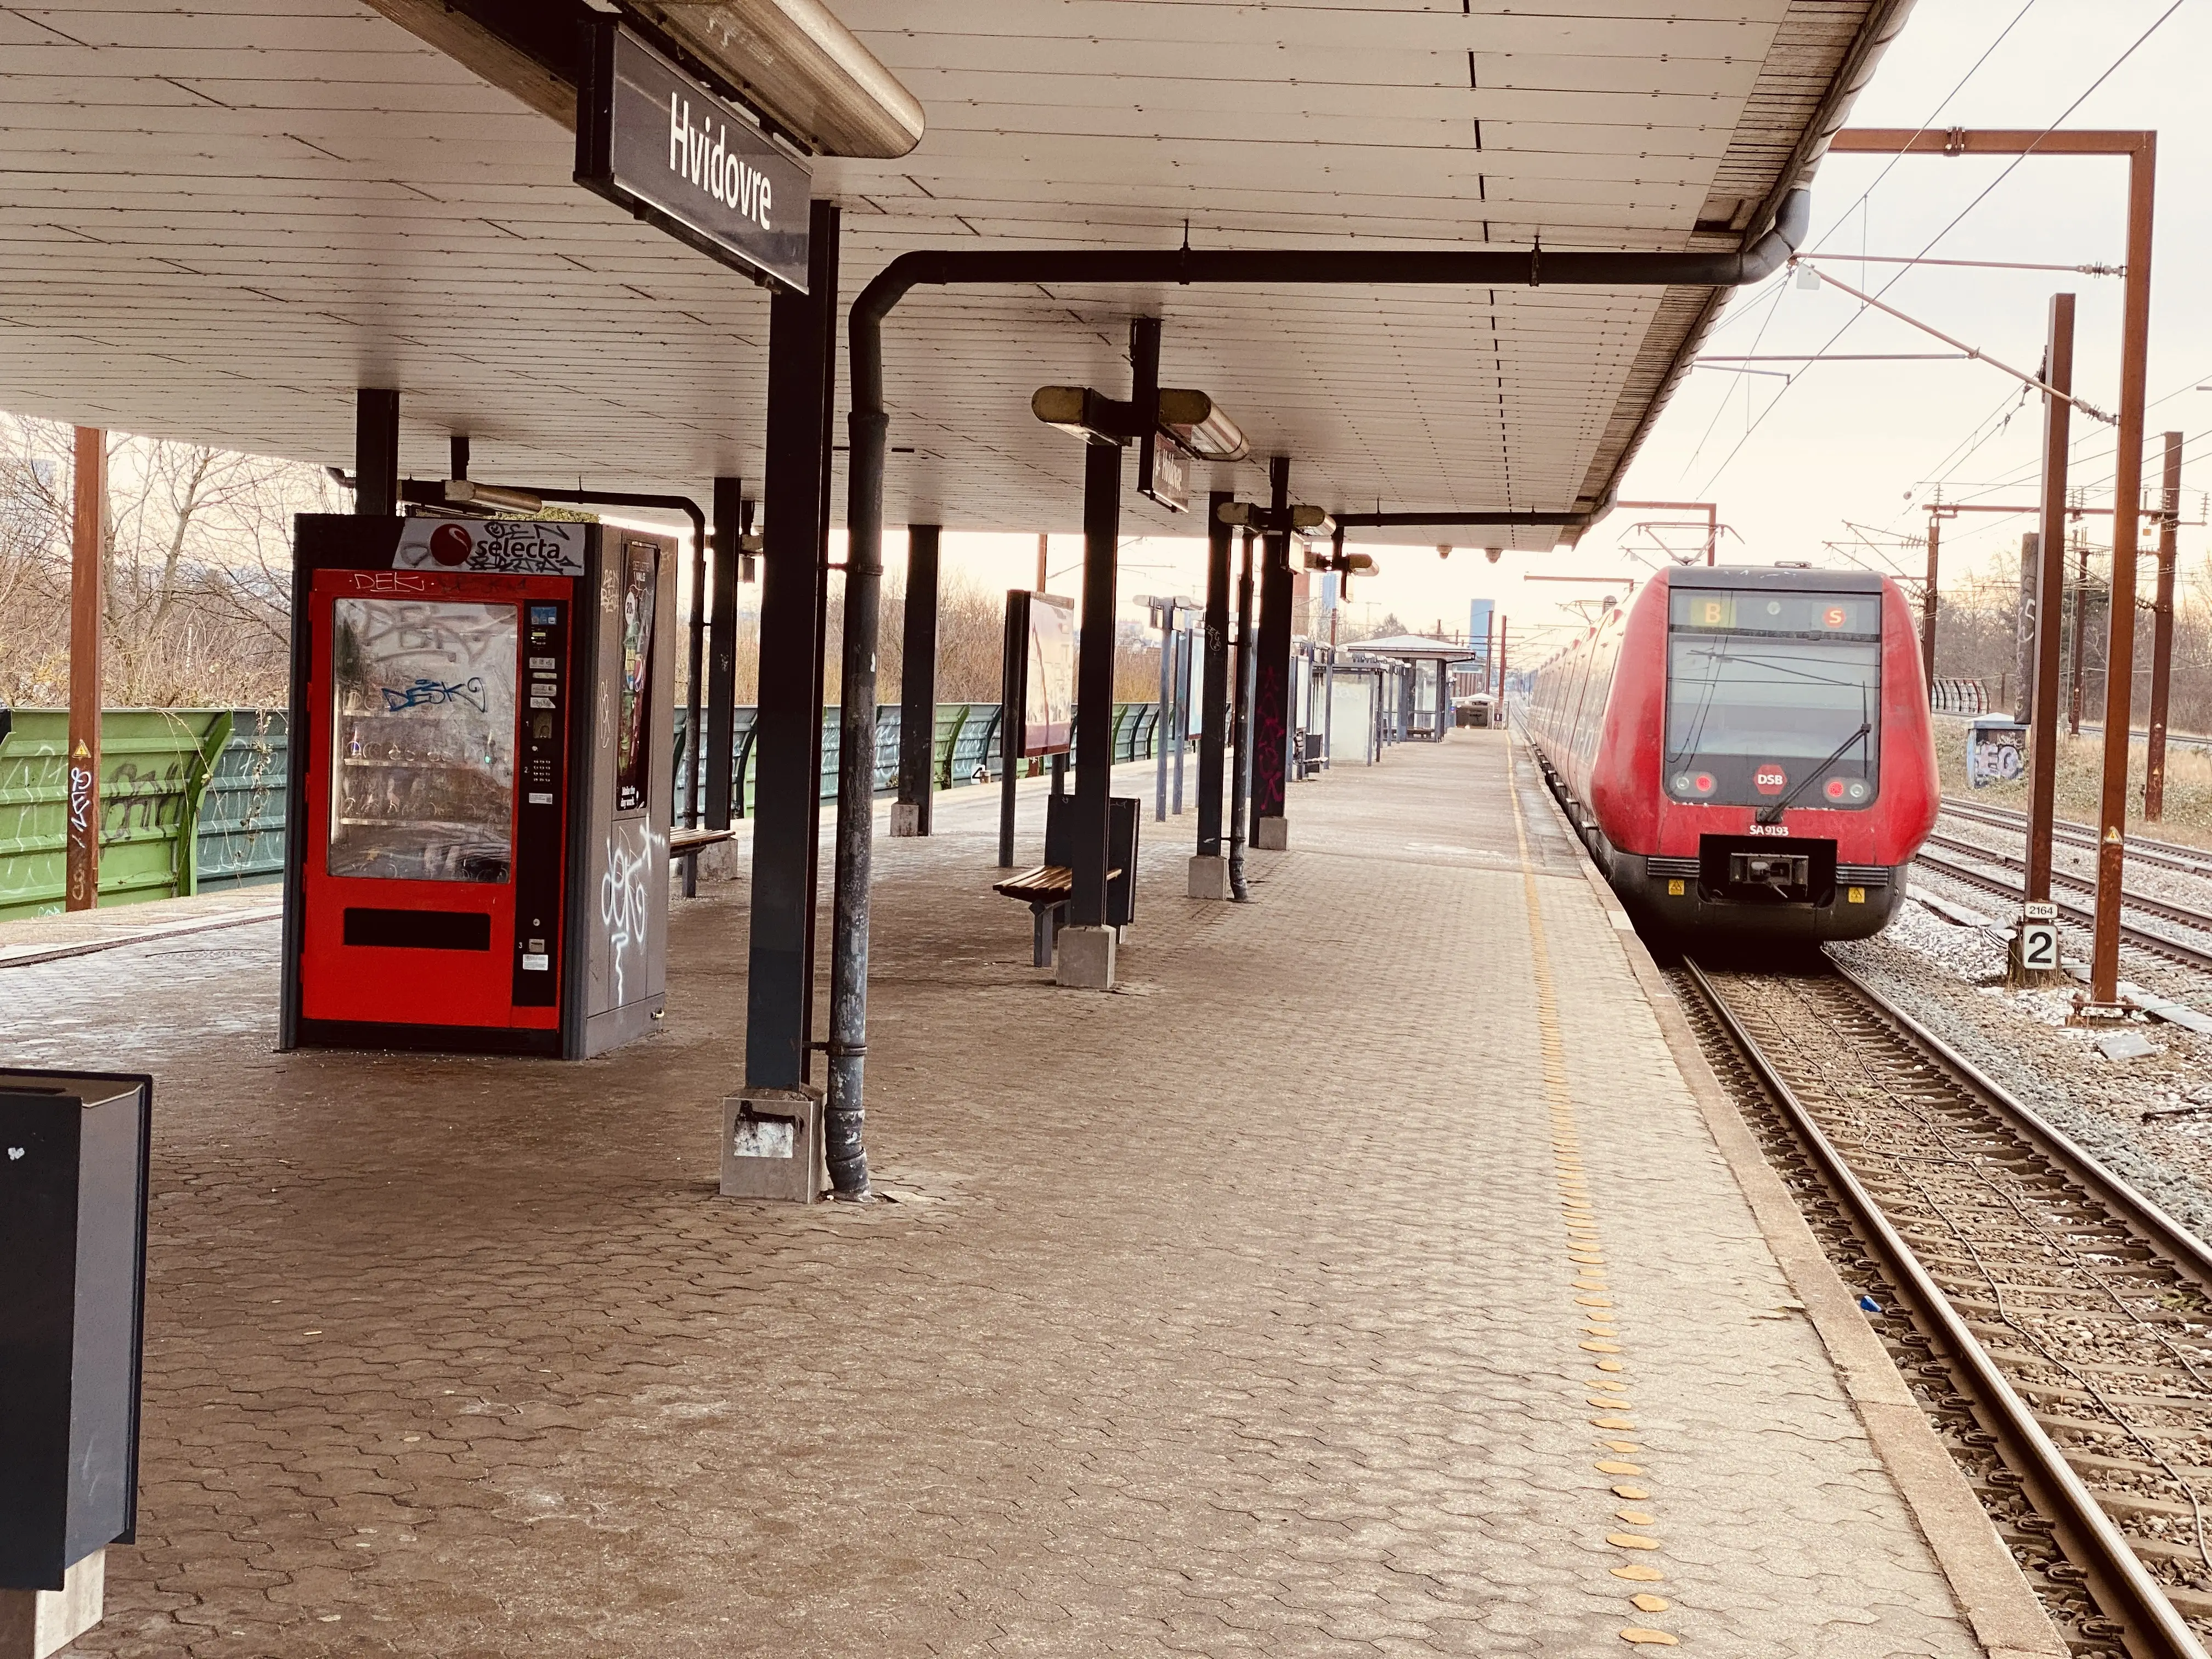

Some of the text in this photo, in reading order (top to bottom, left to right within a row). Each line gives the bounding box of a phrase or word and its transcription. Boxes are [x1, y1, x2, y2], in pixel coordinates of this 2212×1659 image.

[669, 91, 772, 231] Hvidovre
[475, 538, 561, 560] selecta
[1704, 602, 1722, 623] B
[1828, 610, 1843, 625] S
[1757, 774, 1783, 786] DSB
[1749, 825, 1789, 837] SA 9193
[2029, 906, 2053, 916] 2164
[2027, 931, 2052, 964] 2
